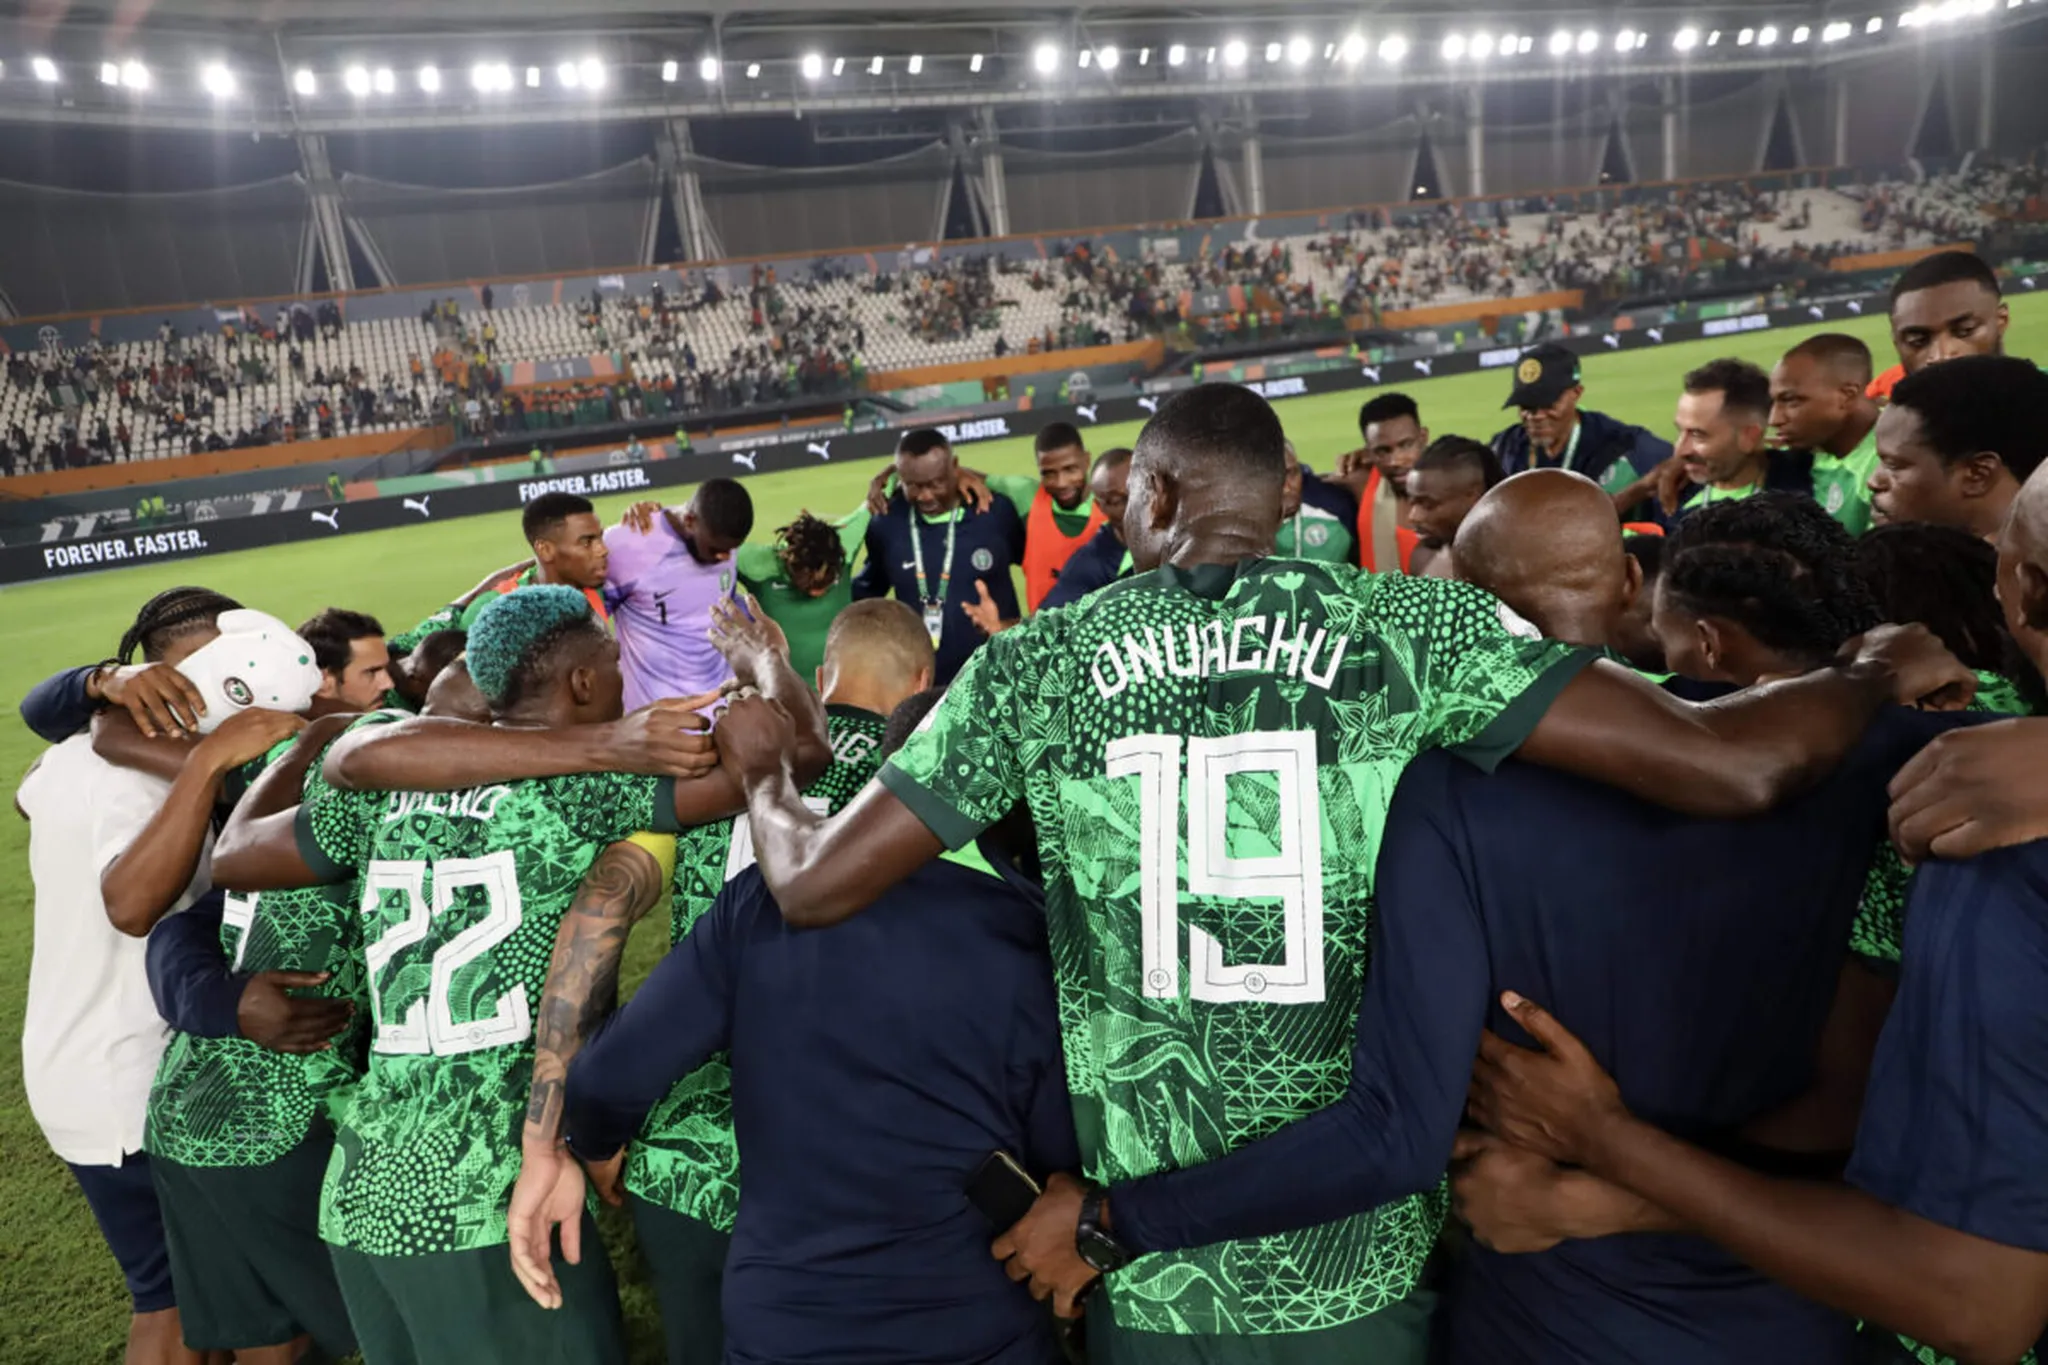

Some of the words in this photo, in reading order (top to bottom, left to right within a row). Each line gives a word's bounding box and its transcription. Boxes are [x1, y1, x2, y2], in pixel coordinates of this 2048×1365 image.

[590, 468, 650, 492] FASTER.
[44, 535, 134, 569] FOREVER.
[134, 528, 208, 556] FASTER.
[1090, 615, 1350, 700] ONUACHU
[1105, 730, 1326, 1004] 19
[359, 849, 531, 1057] 22
